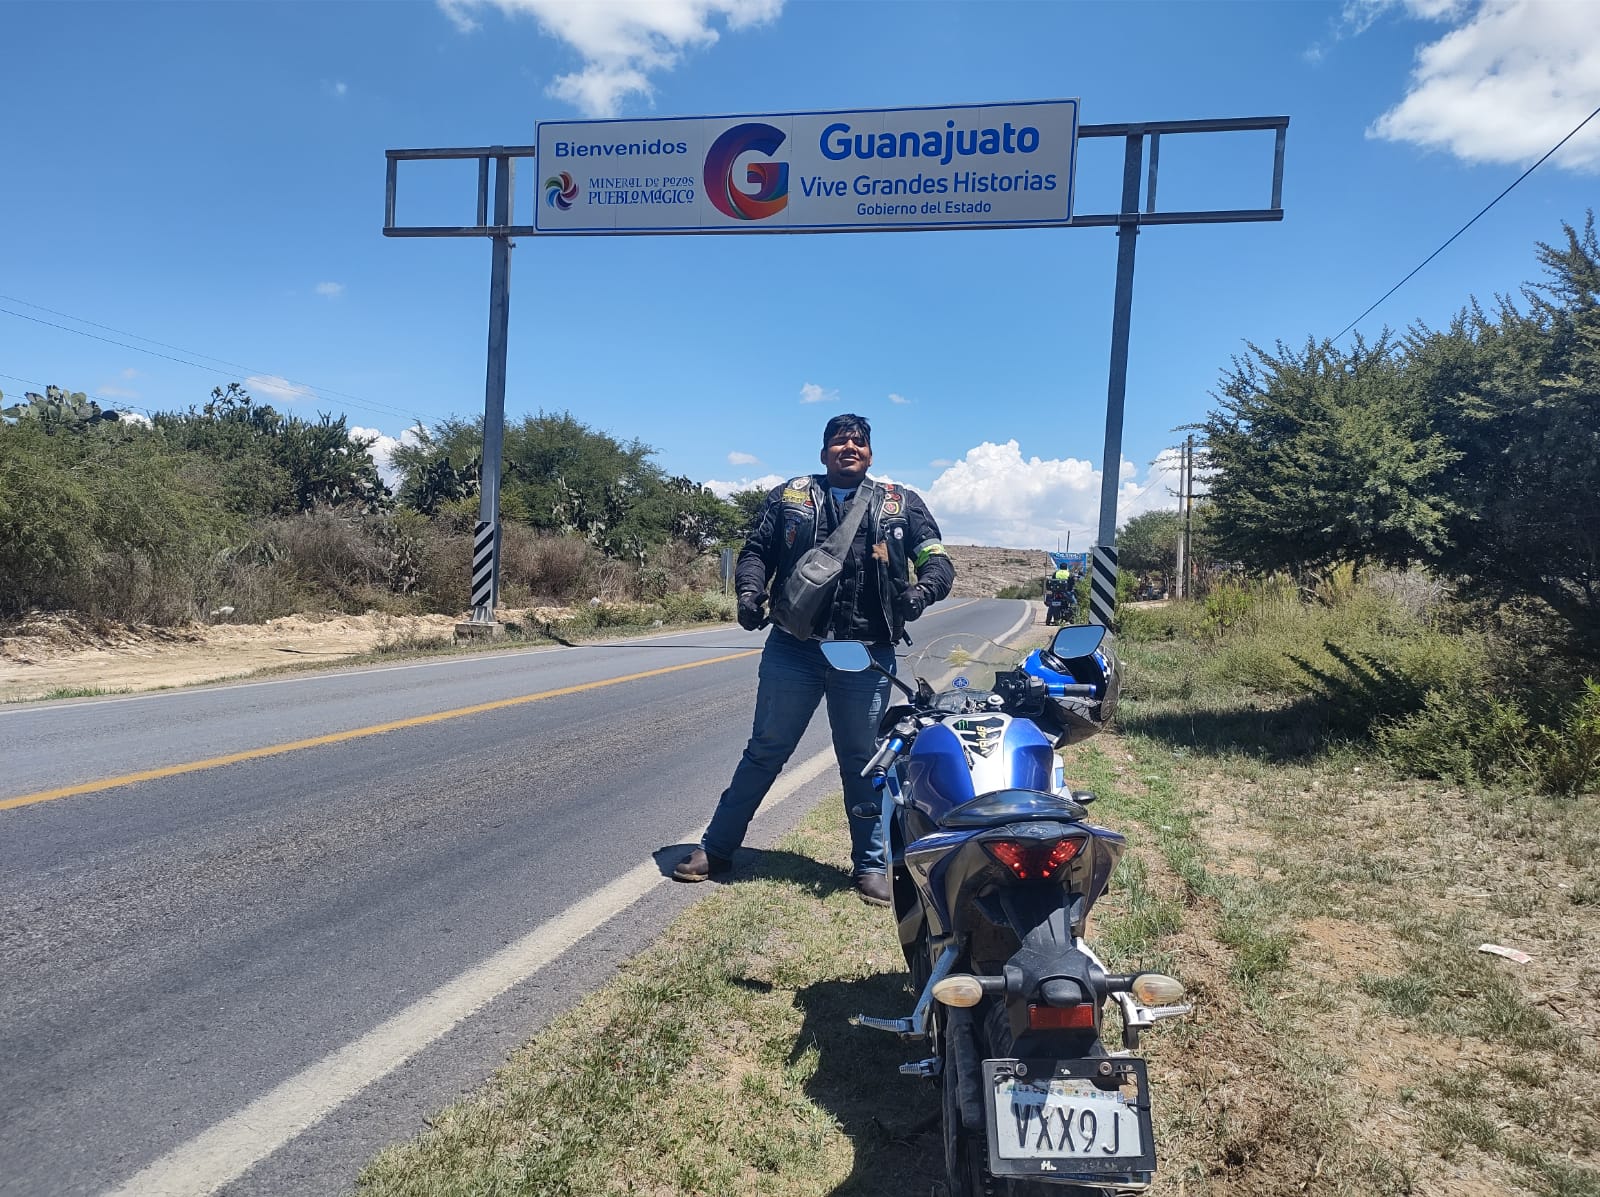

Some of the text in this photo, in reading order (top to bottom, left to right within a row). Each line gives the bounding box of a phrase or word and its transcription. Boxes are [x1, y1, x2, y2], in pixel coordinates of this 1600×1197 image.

[556, 139, 688, 158] Bienvenidos
[820, 120, 1040, 165] Guanajuato
[800, 169, 1057, 198] Vive Grandes Historias
[857, 200, 992, 216] Gobierno del Estado
[1014, 1103, 1120, 1155] VXX9J
